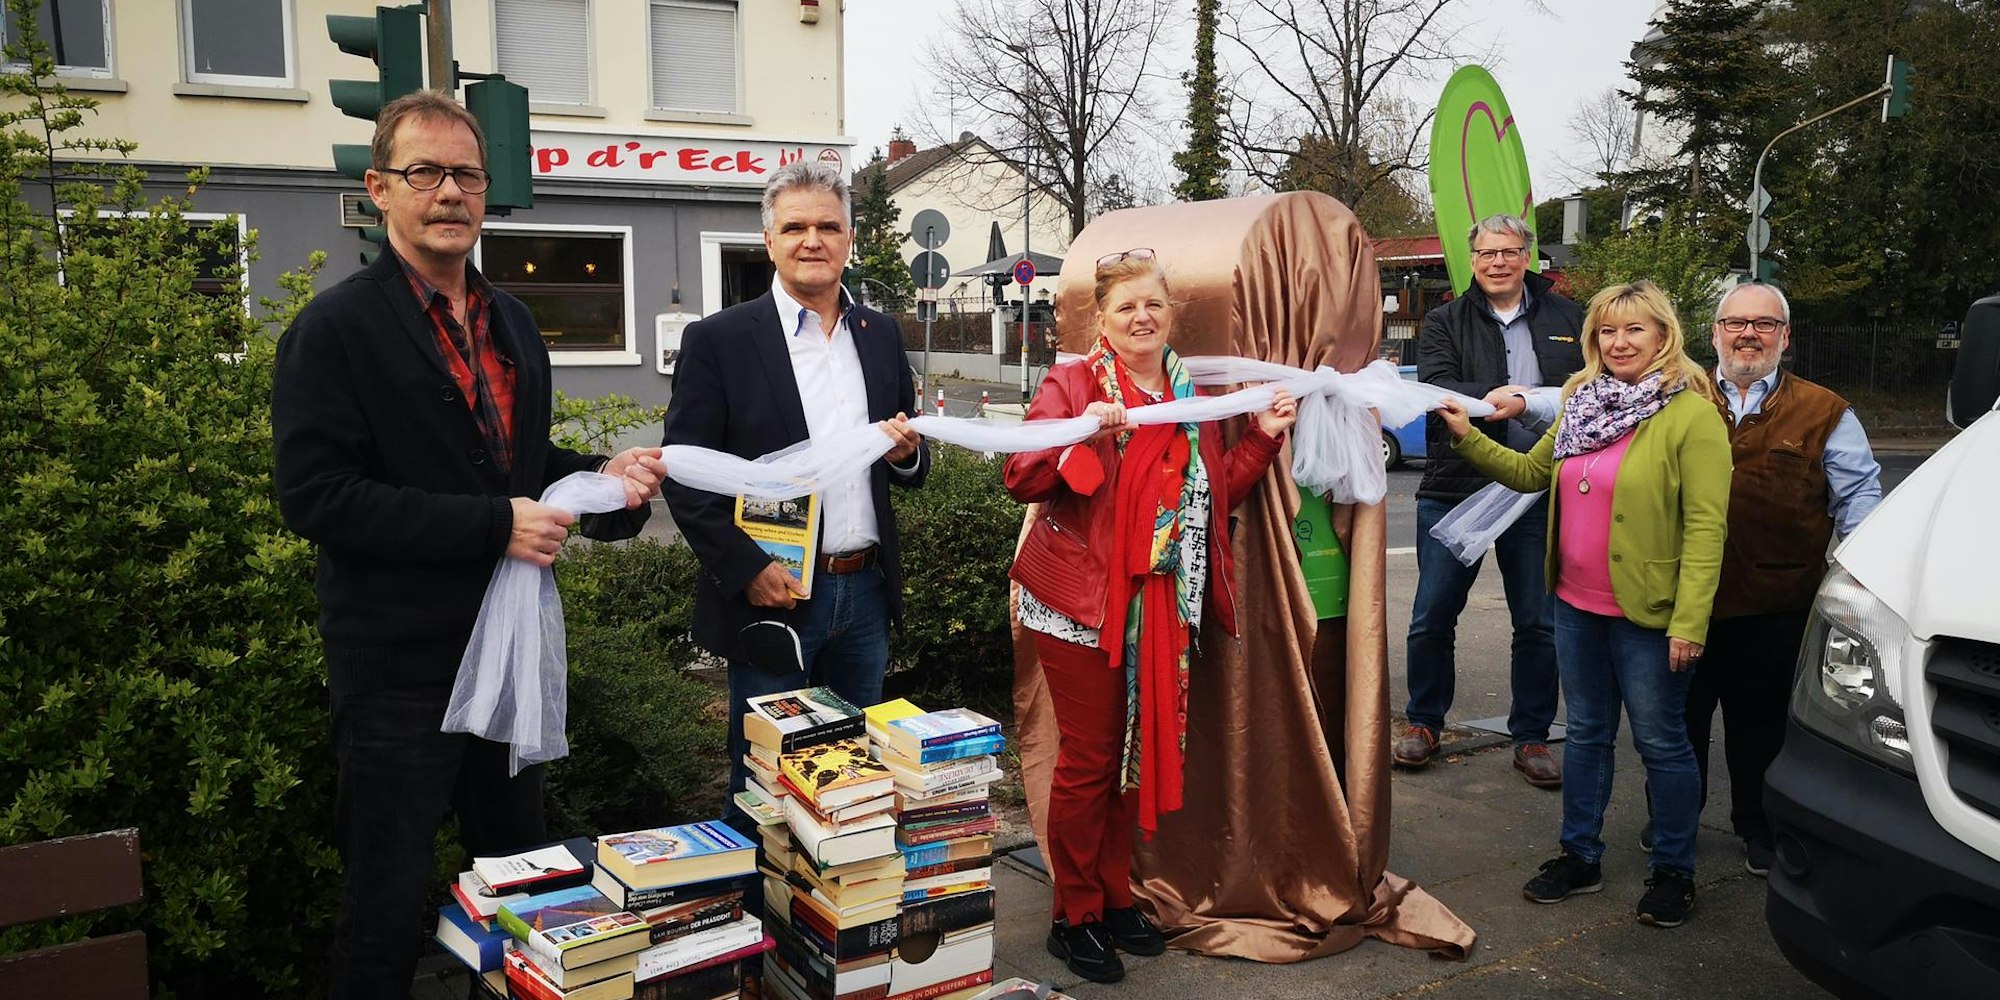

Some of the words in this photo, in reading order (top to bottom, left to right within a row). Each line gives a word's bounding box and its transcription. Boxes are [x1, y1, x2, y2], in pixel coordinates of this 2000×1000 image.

[530, 145, 569, 173] p
[677, 148, 767, 174] Eck
[653, 931, 666, 940] SAM
[667, 924, 689, 936] BOURNE
[690, 919, 702, 929] DER
[702, 911, 731, 926] PRÄSIDENT
[925, 986, 939, 996] DEN
[940, 980, 967, 992] KIEFERN
